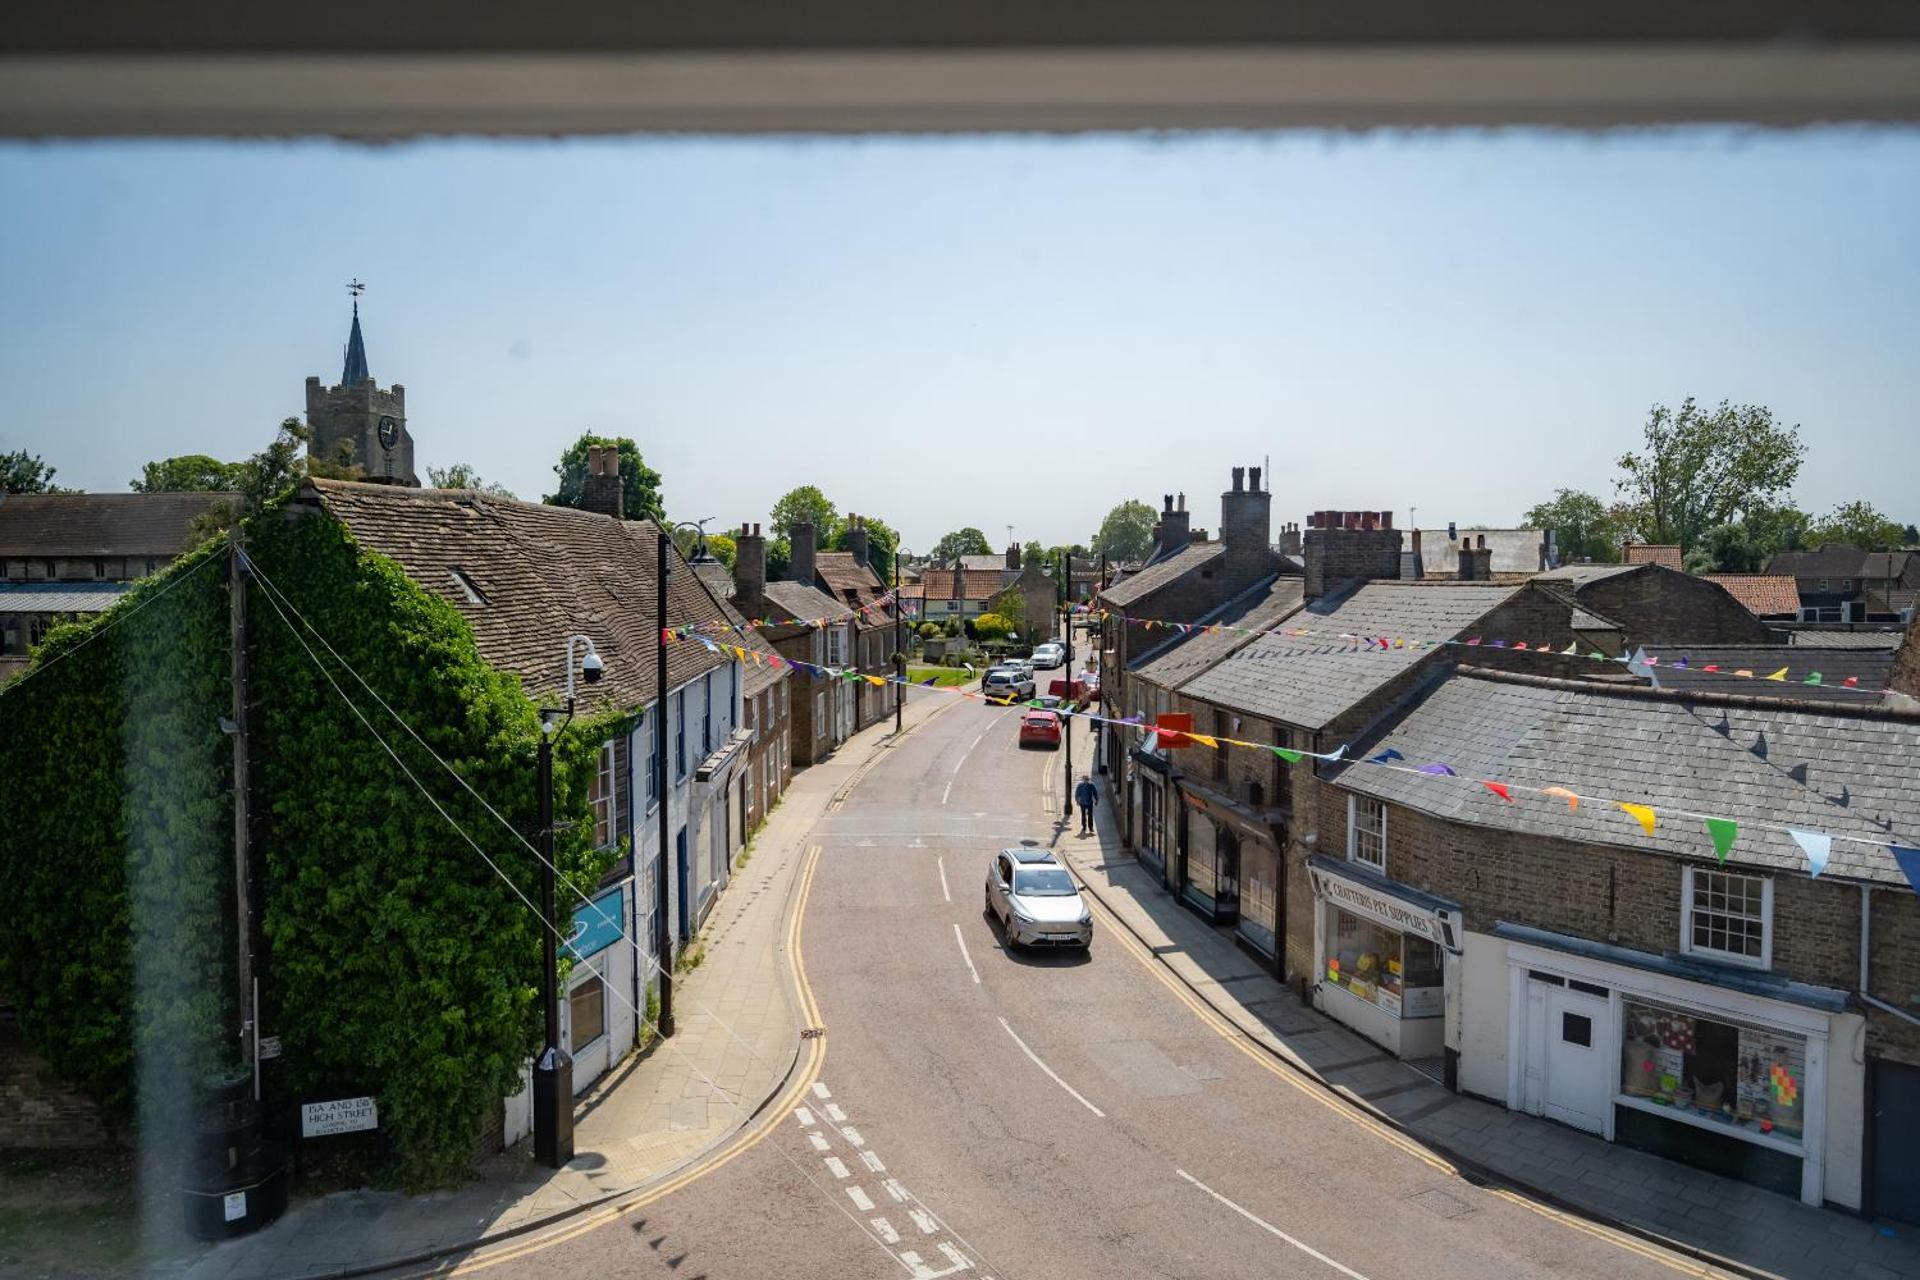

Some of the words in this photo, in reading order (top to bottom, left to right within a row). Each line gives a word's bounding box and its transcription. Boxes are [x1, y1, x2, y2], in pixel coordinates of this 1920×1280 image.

[1373, 900, 1389, 917] PET
[1388, 904, 1429, 932] SUPPLIES
[329, 1101, 352, 1110] AND
[309, 1112, 334, 1123] HIGH
[338, 1107, 372, 1119] STREET
